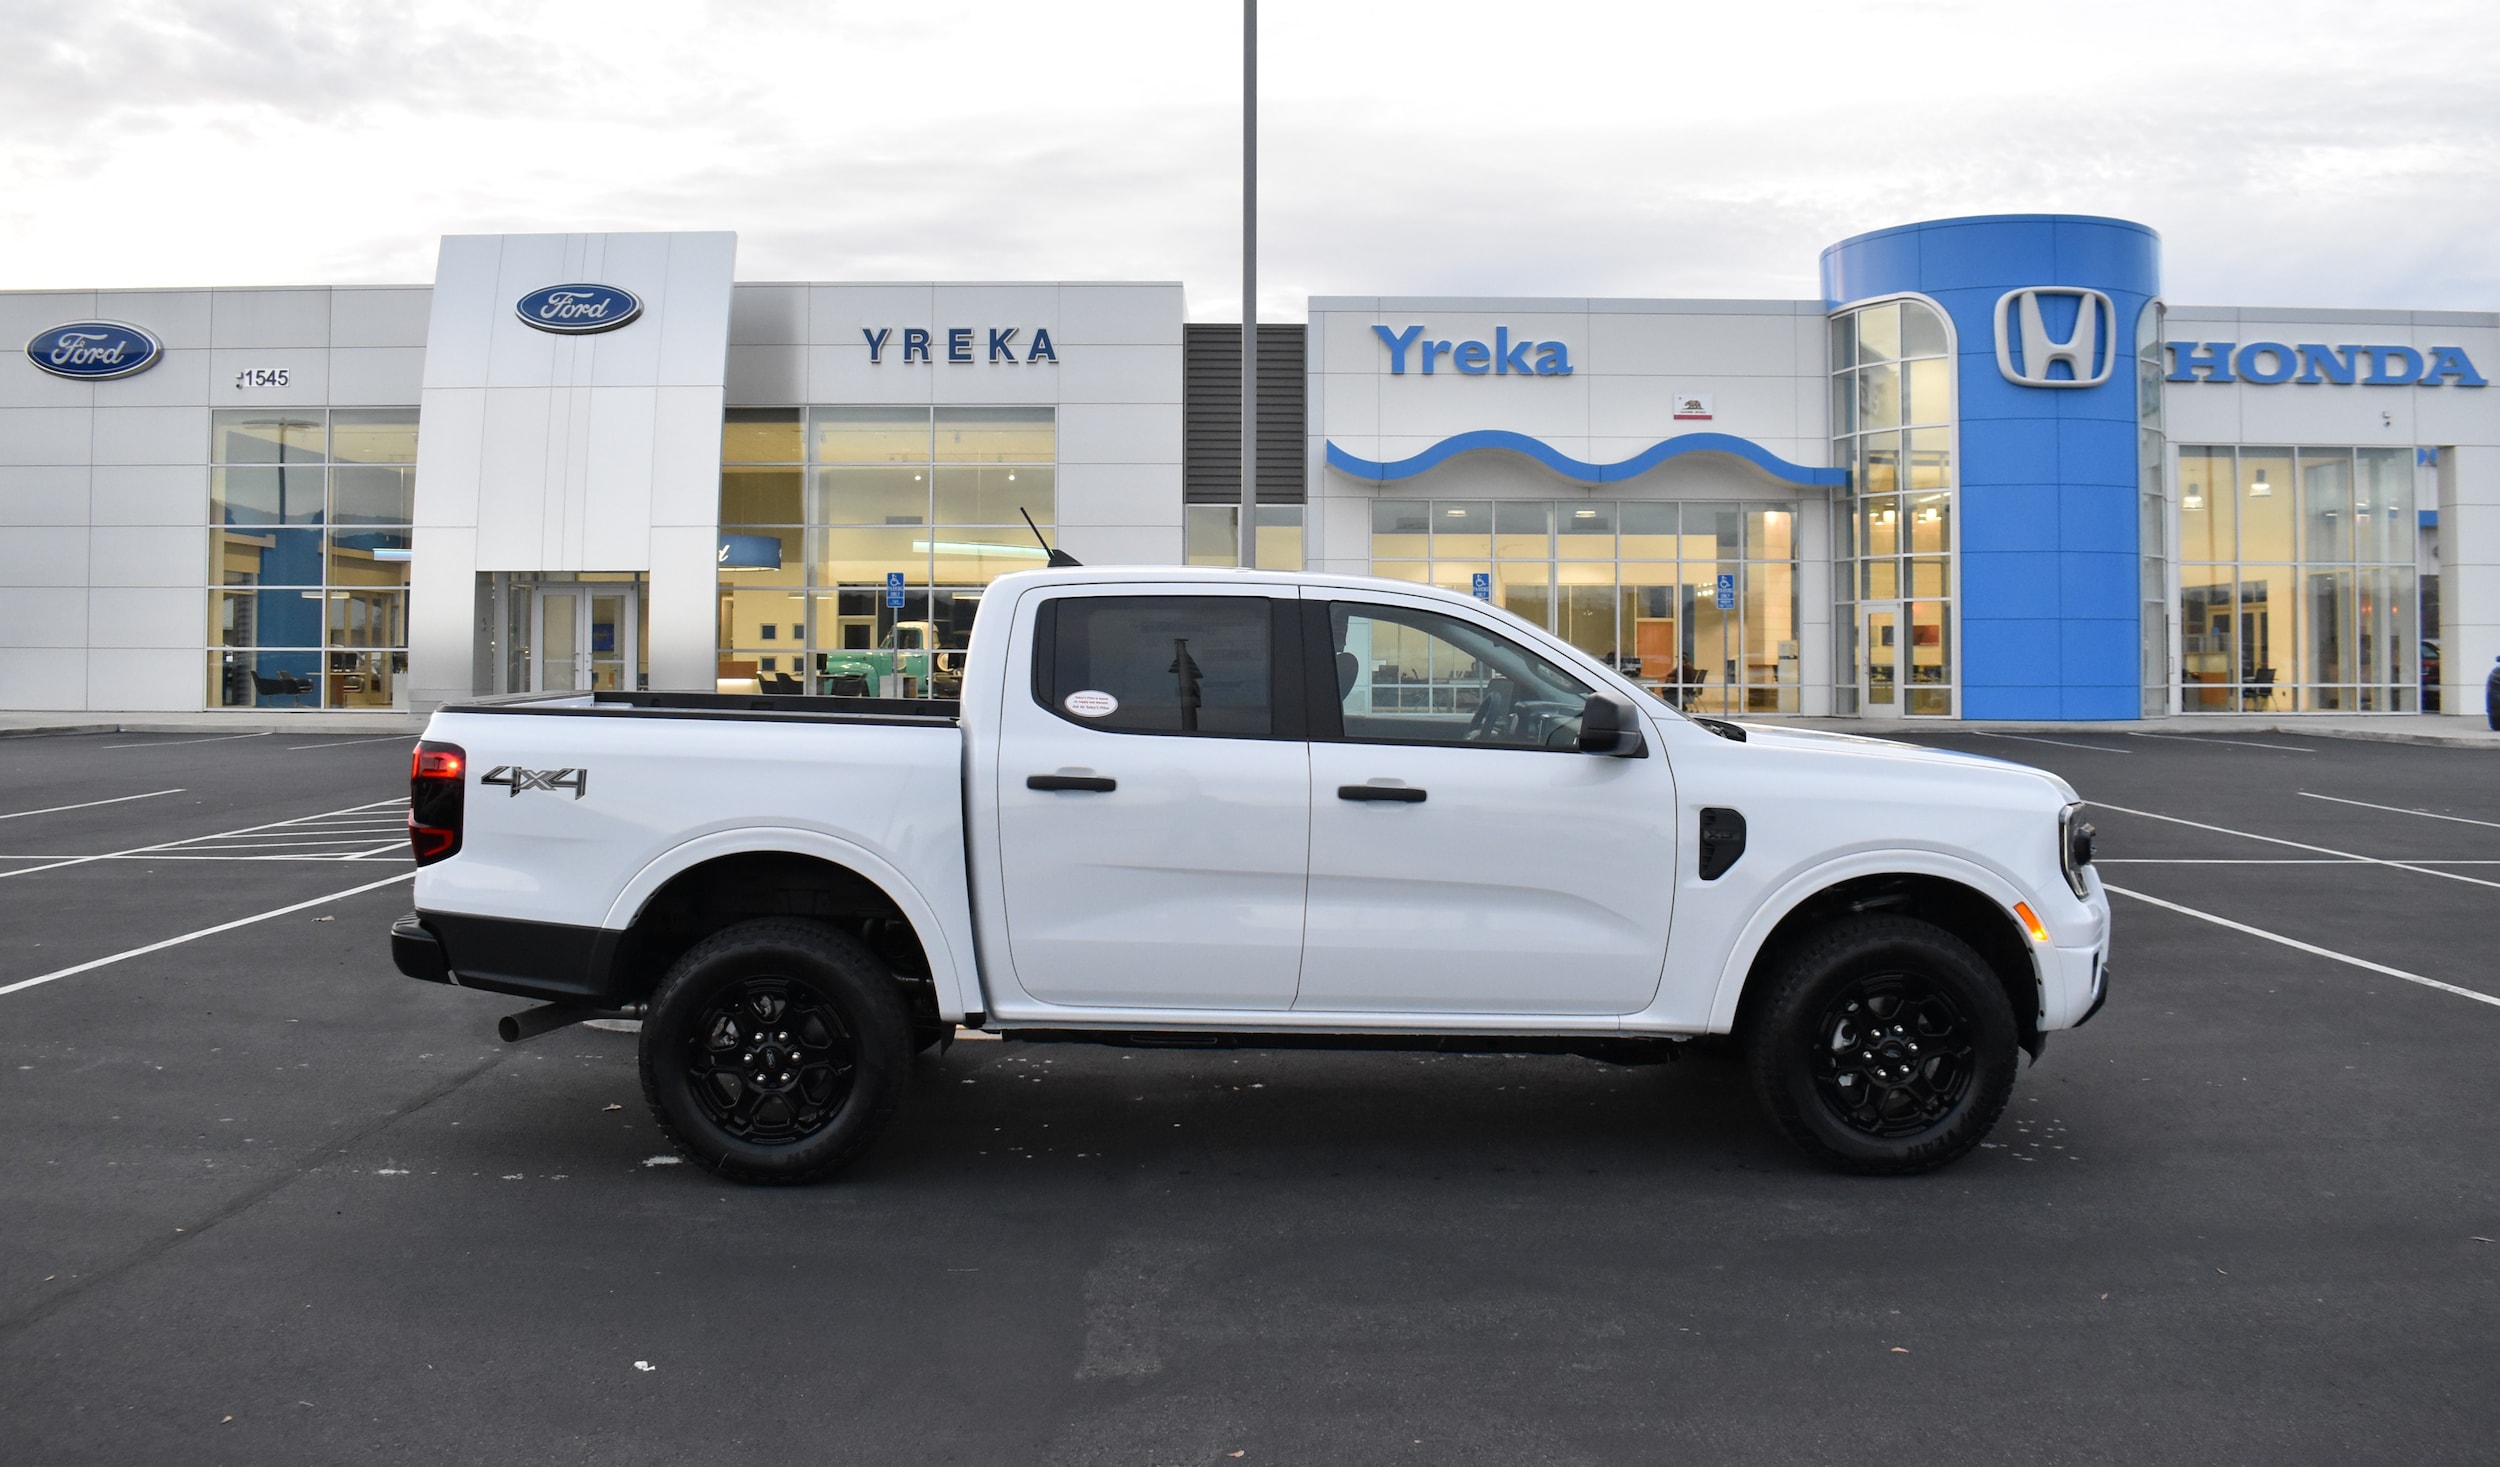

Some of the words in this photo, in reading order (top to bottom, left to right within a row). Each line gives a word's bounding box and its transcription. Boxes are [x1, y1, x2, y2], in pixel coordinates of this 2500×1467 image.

[540, 291, 612, 319] Ford
[50, 332, 127, 365] Ford
[861, 327, 1060, 364] YREKA
[1371, 324, 1575, 376] Yreka
[245, 369, 289, 386] 1545
[2165, 341, 2490, 386] HONDA
